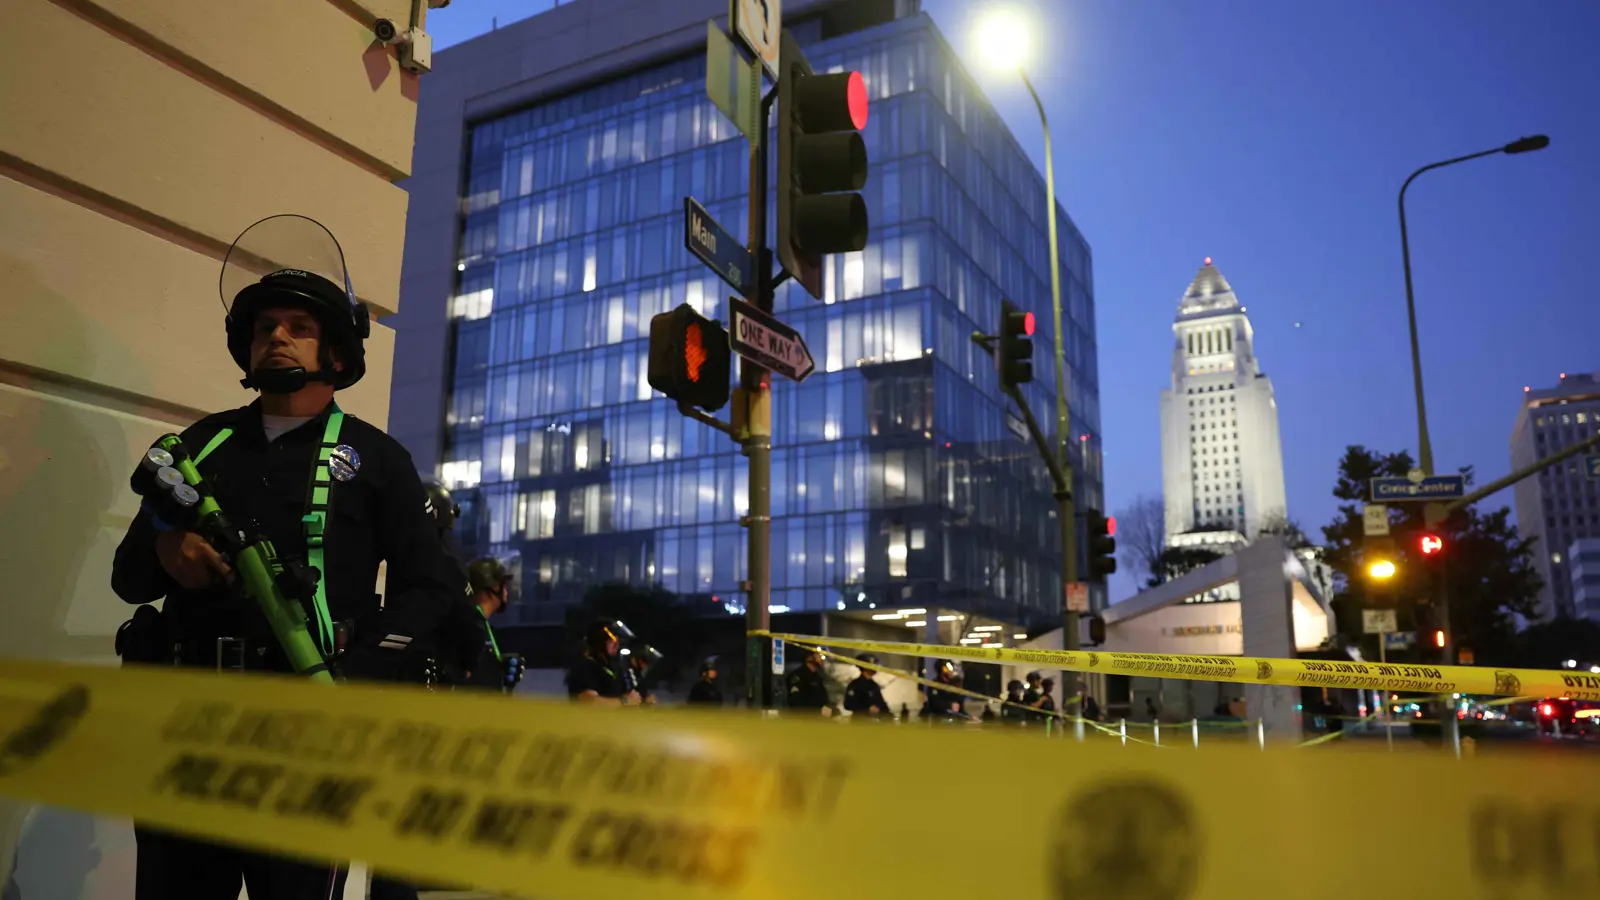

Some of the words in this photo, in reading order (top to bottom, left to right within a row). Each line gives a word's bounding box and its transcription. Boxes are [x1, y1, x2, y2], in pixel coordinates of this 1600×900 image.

[692, 211, 716, 255] Main
[741, 319, 764, 348] ONE
[768, 332, 792, 361] WAY
[1415, 482, 1456, 494] Center
[1301, 662, 1333, 671] CROSS
[1333, 663, 1354, 673] NOT
[1353, 664, 1369, 674] DO
[1375, 665, 1402, 676] LINE
[1400, 666, 1442, 679] POLICE
[394, 785, 469, 847] DO
[463, 794, 571, 863] NOT
